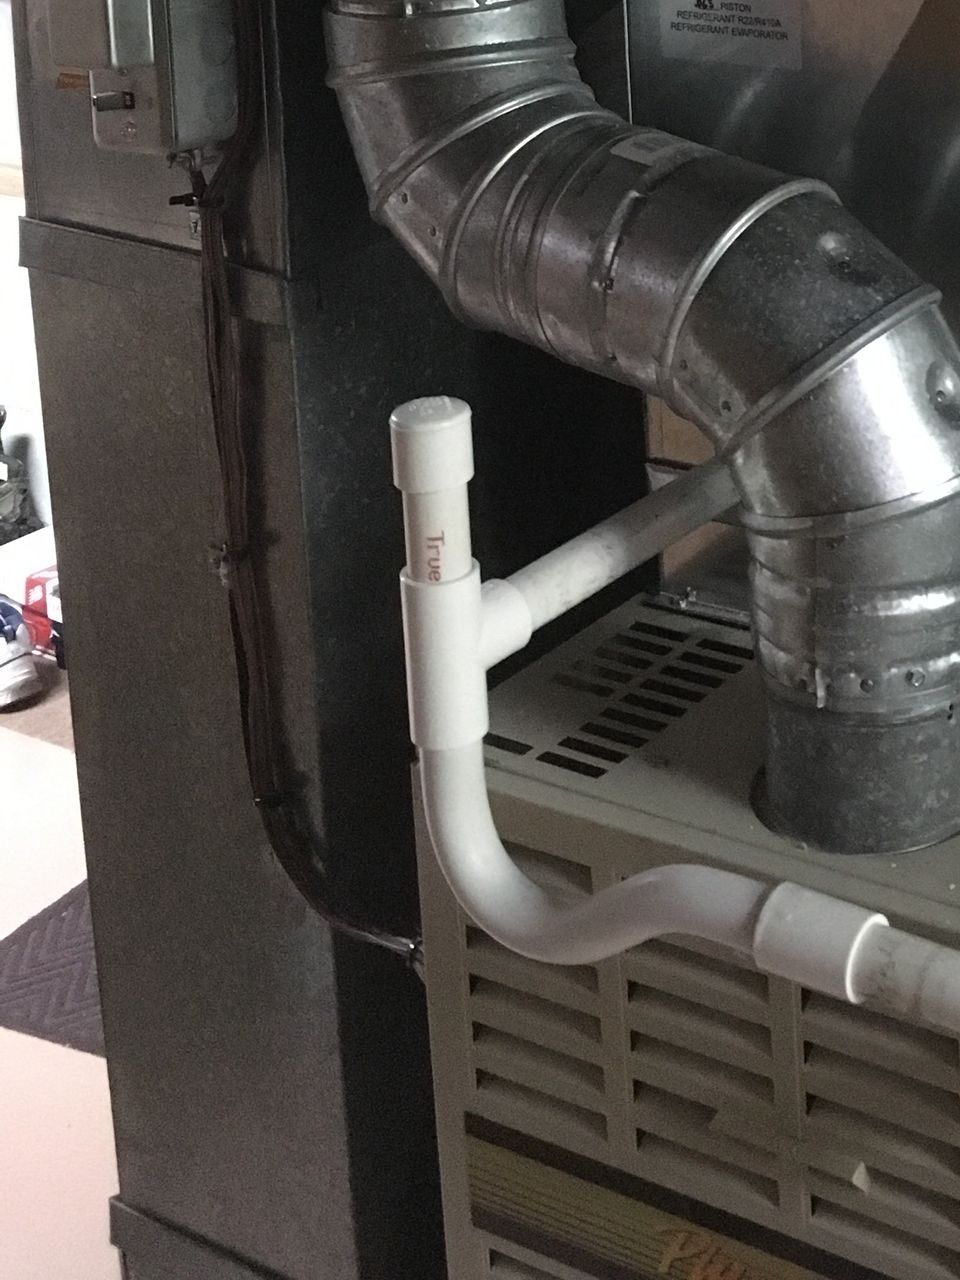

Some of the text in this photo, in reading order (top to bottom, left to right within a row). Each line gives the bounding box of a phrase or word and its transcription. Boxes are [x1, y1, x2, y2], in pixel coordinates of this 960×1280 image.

[720, 2, 752, 13] PISTON
[677, 10, 736, 24] REFRIGERANT
[671, 22, 788, 40] REFRIGERANT EVAPORATOR
[426, 530, 445, 582] True
